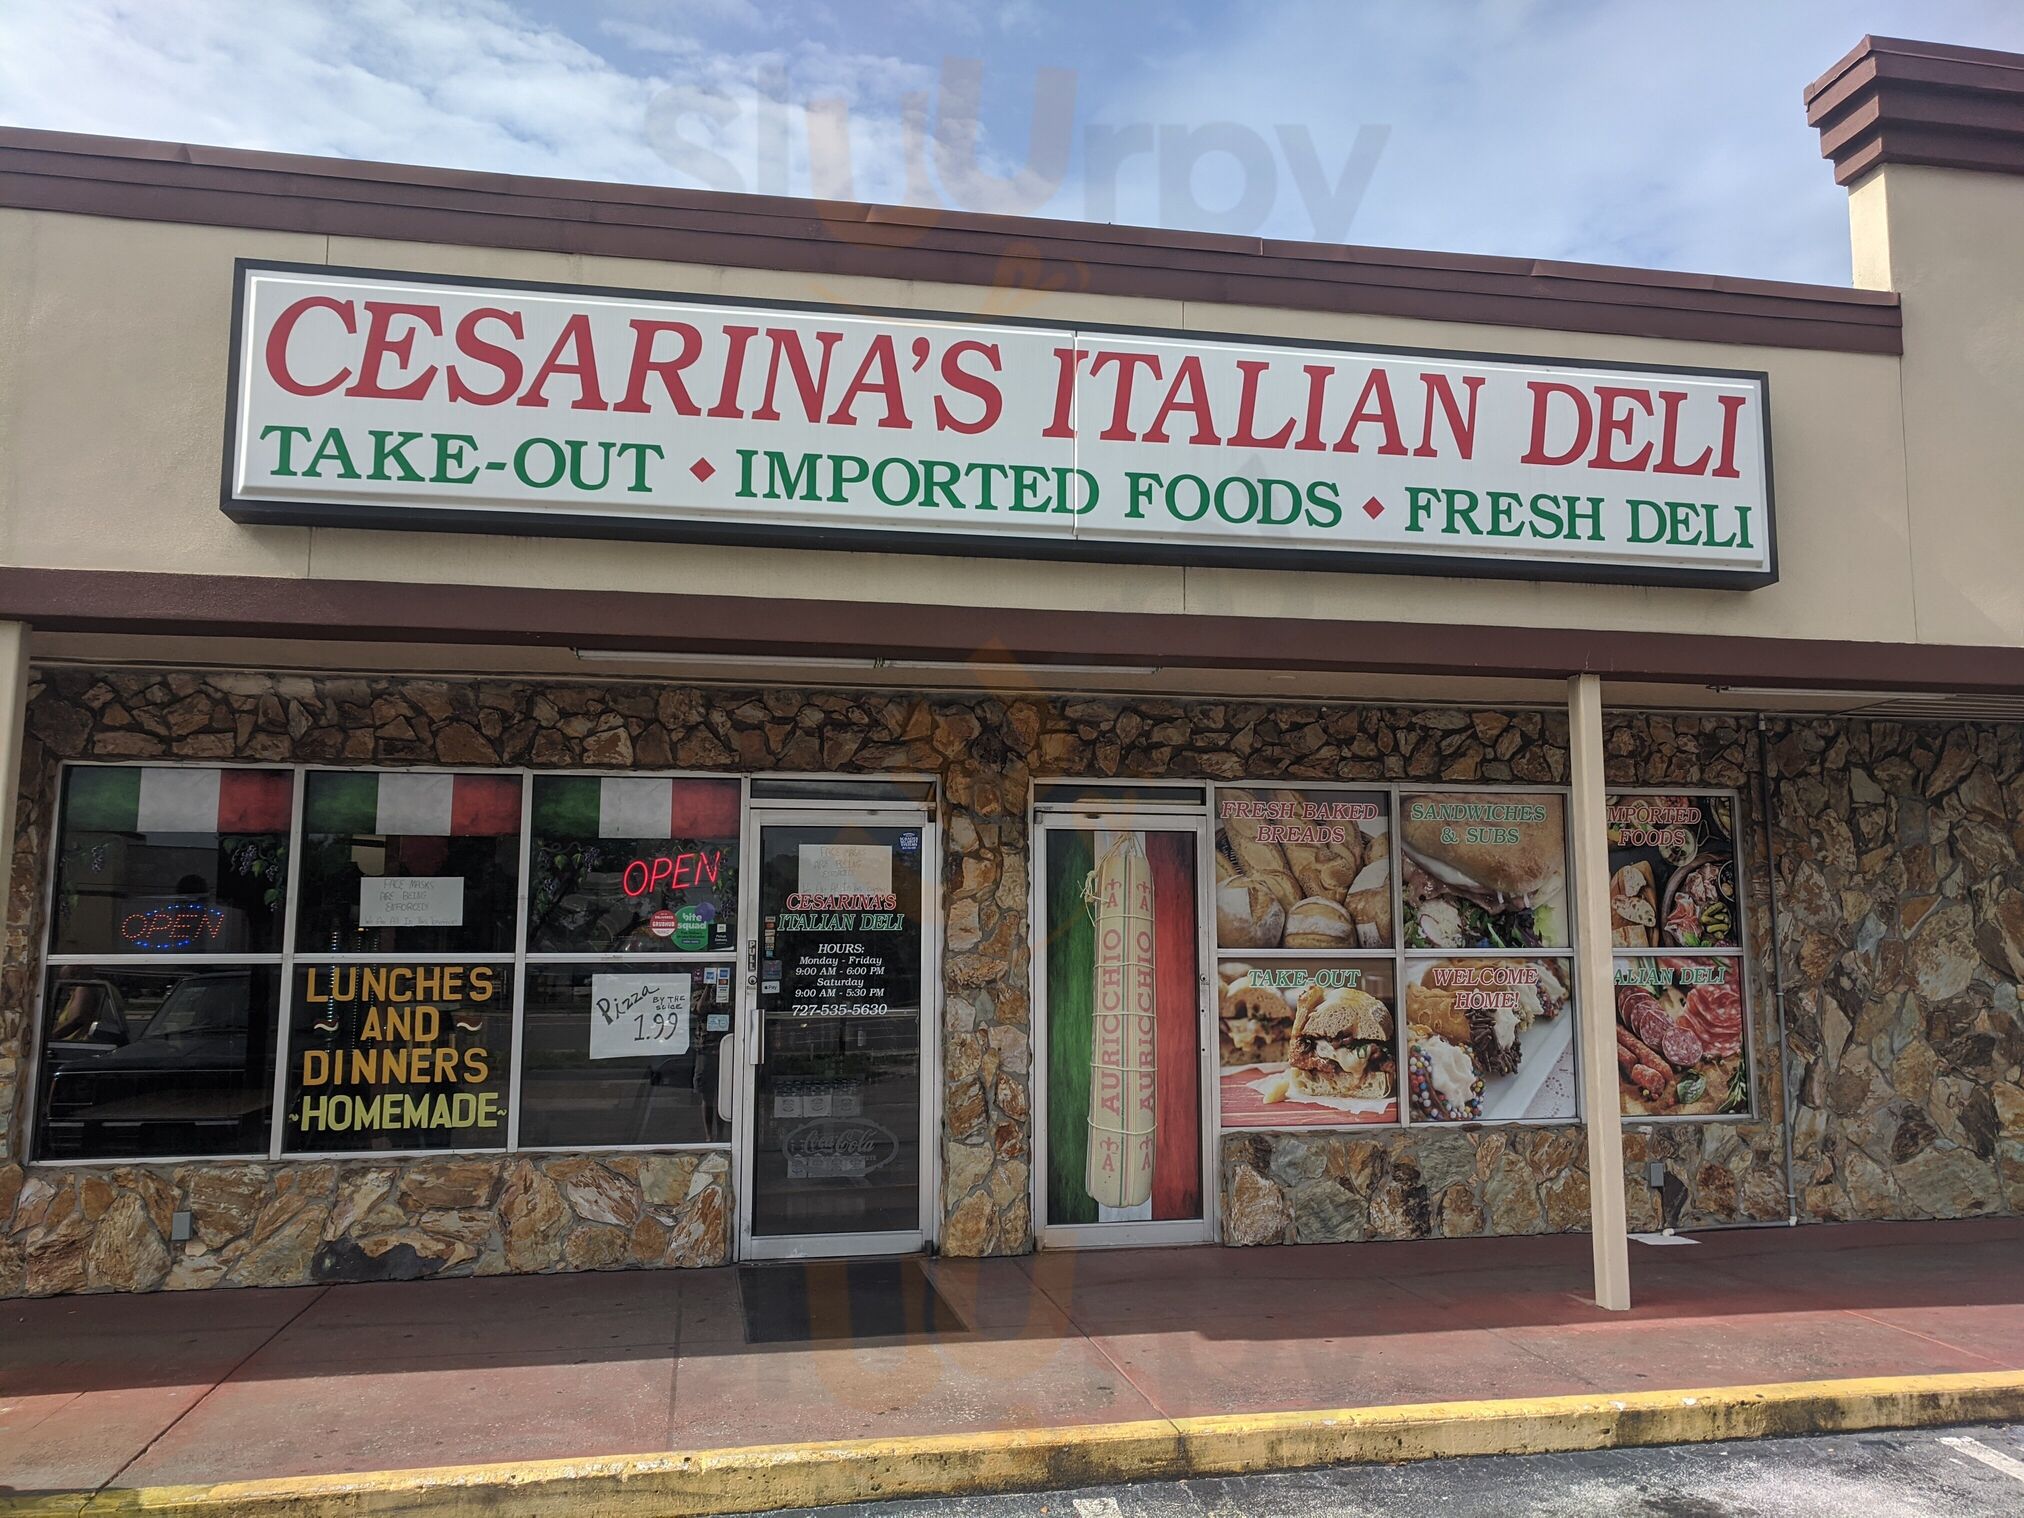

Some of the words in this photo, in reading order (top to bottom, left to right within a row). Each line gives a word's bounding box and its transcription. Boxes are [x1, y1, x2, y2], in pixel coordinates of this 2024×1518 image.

[265, 296, 1001, 434] CESARINA'S
[1043, 348, 1485, 459] ITALIAN
[1521, 381, 1746, 479] DELI
[259, 425, 665, 493] TAKE-OUT
[735, 449, 1100, 516] IMPORTED
[1124, 471, 1343, 528] FOODS
[1405, 486, 1605, 541] FRESH
[1626, 499, 1754, 548] DELI
[1221, 800, 1297, 820] FRESH
[1301, 802, 1378, 821] BAKED
[1411, 803, 1546, 822] SANDWICHES
[1607, 806, 1702, 824] MPORTED
[1256, 825, 1345, 843] BREADS
[1440, 828, 1458, 844] &
[1466, 827, 1520, 844] SUBS
[1618, 829, 1686, 846] FOODS
[622, 850, 721, 897] OPEN
[786, 893, 897, 911] CESARINA'S
[120, 911, 225, 940] OPEN
[677, 921, 706, 931] squad
[683, 913, 702, 922] bite
[777, 913, 855, 931] ITALIAN
[859, 913, 904, 931] DELI
[748, 941, 756, 970] PULL
[817, 943, 865, 954] HOURS:
[800, 956, 839, 966] Monday
[848, 956, 882, 966] Friday
[795, 967, 817, 976] 9:00
[819, 967, 837, 976] AM
[846, 967, 867, 976] 6:00
[869, 966, 885, 975] PM
[1249, 969, 1361, 988] TAKE-OUT
[1433, 968, 1538, 986] WELCOME
[1613, 967, 1674, 985] ALIAN
[1679, 966, 1726, 985] DELI
[306, 966, 494, 1002] LUNCHES
[817, 978, 864, 988] Saturday
[653, 996, 665, 1004] BY
[667, 995, 686, 1003] THE
[795, 989, 817, 998] 9:00
[819, 989, 836, 998] AM
[845, 989, 867, 997] 5:30
[869, 988, 884, 997] PM
[1455, 991, 1520, 1010] HOME!
[596, 985, 660, 1025] Pizza
[792, 1003, 888, 1016] 727-535-5630
[360, 1006, 440, 1042] AND
[633, 1012, 678, 1041] 1.99
[1101, 928, 1122, 1115] AURICCHIO
[1137, 930, 1155, 1112] AURICCHIO
[303, 1047, 489, 1086] DINNERS
[301, 1091, 499, 1132] HOMEMADE
